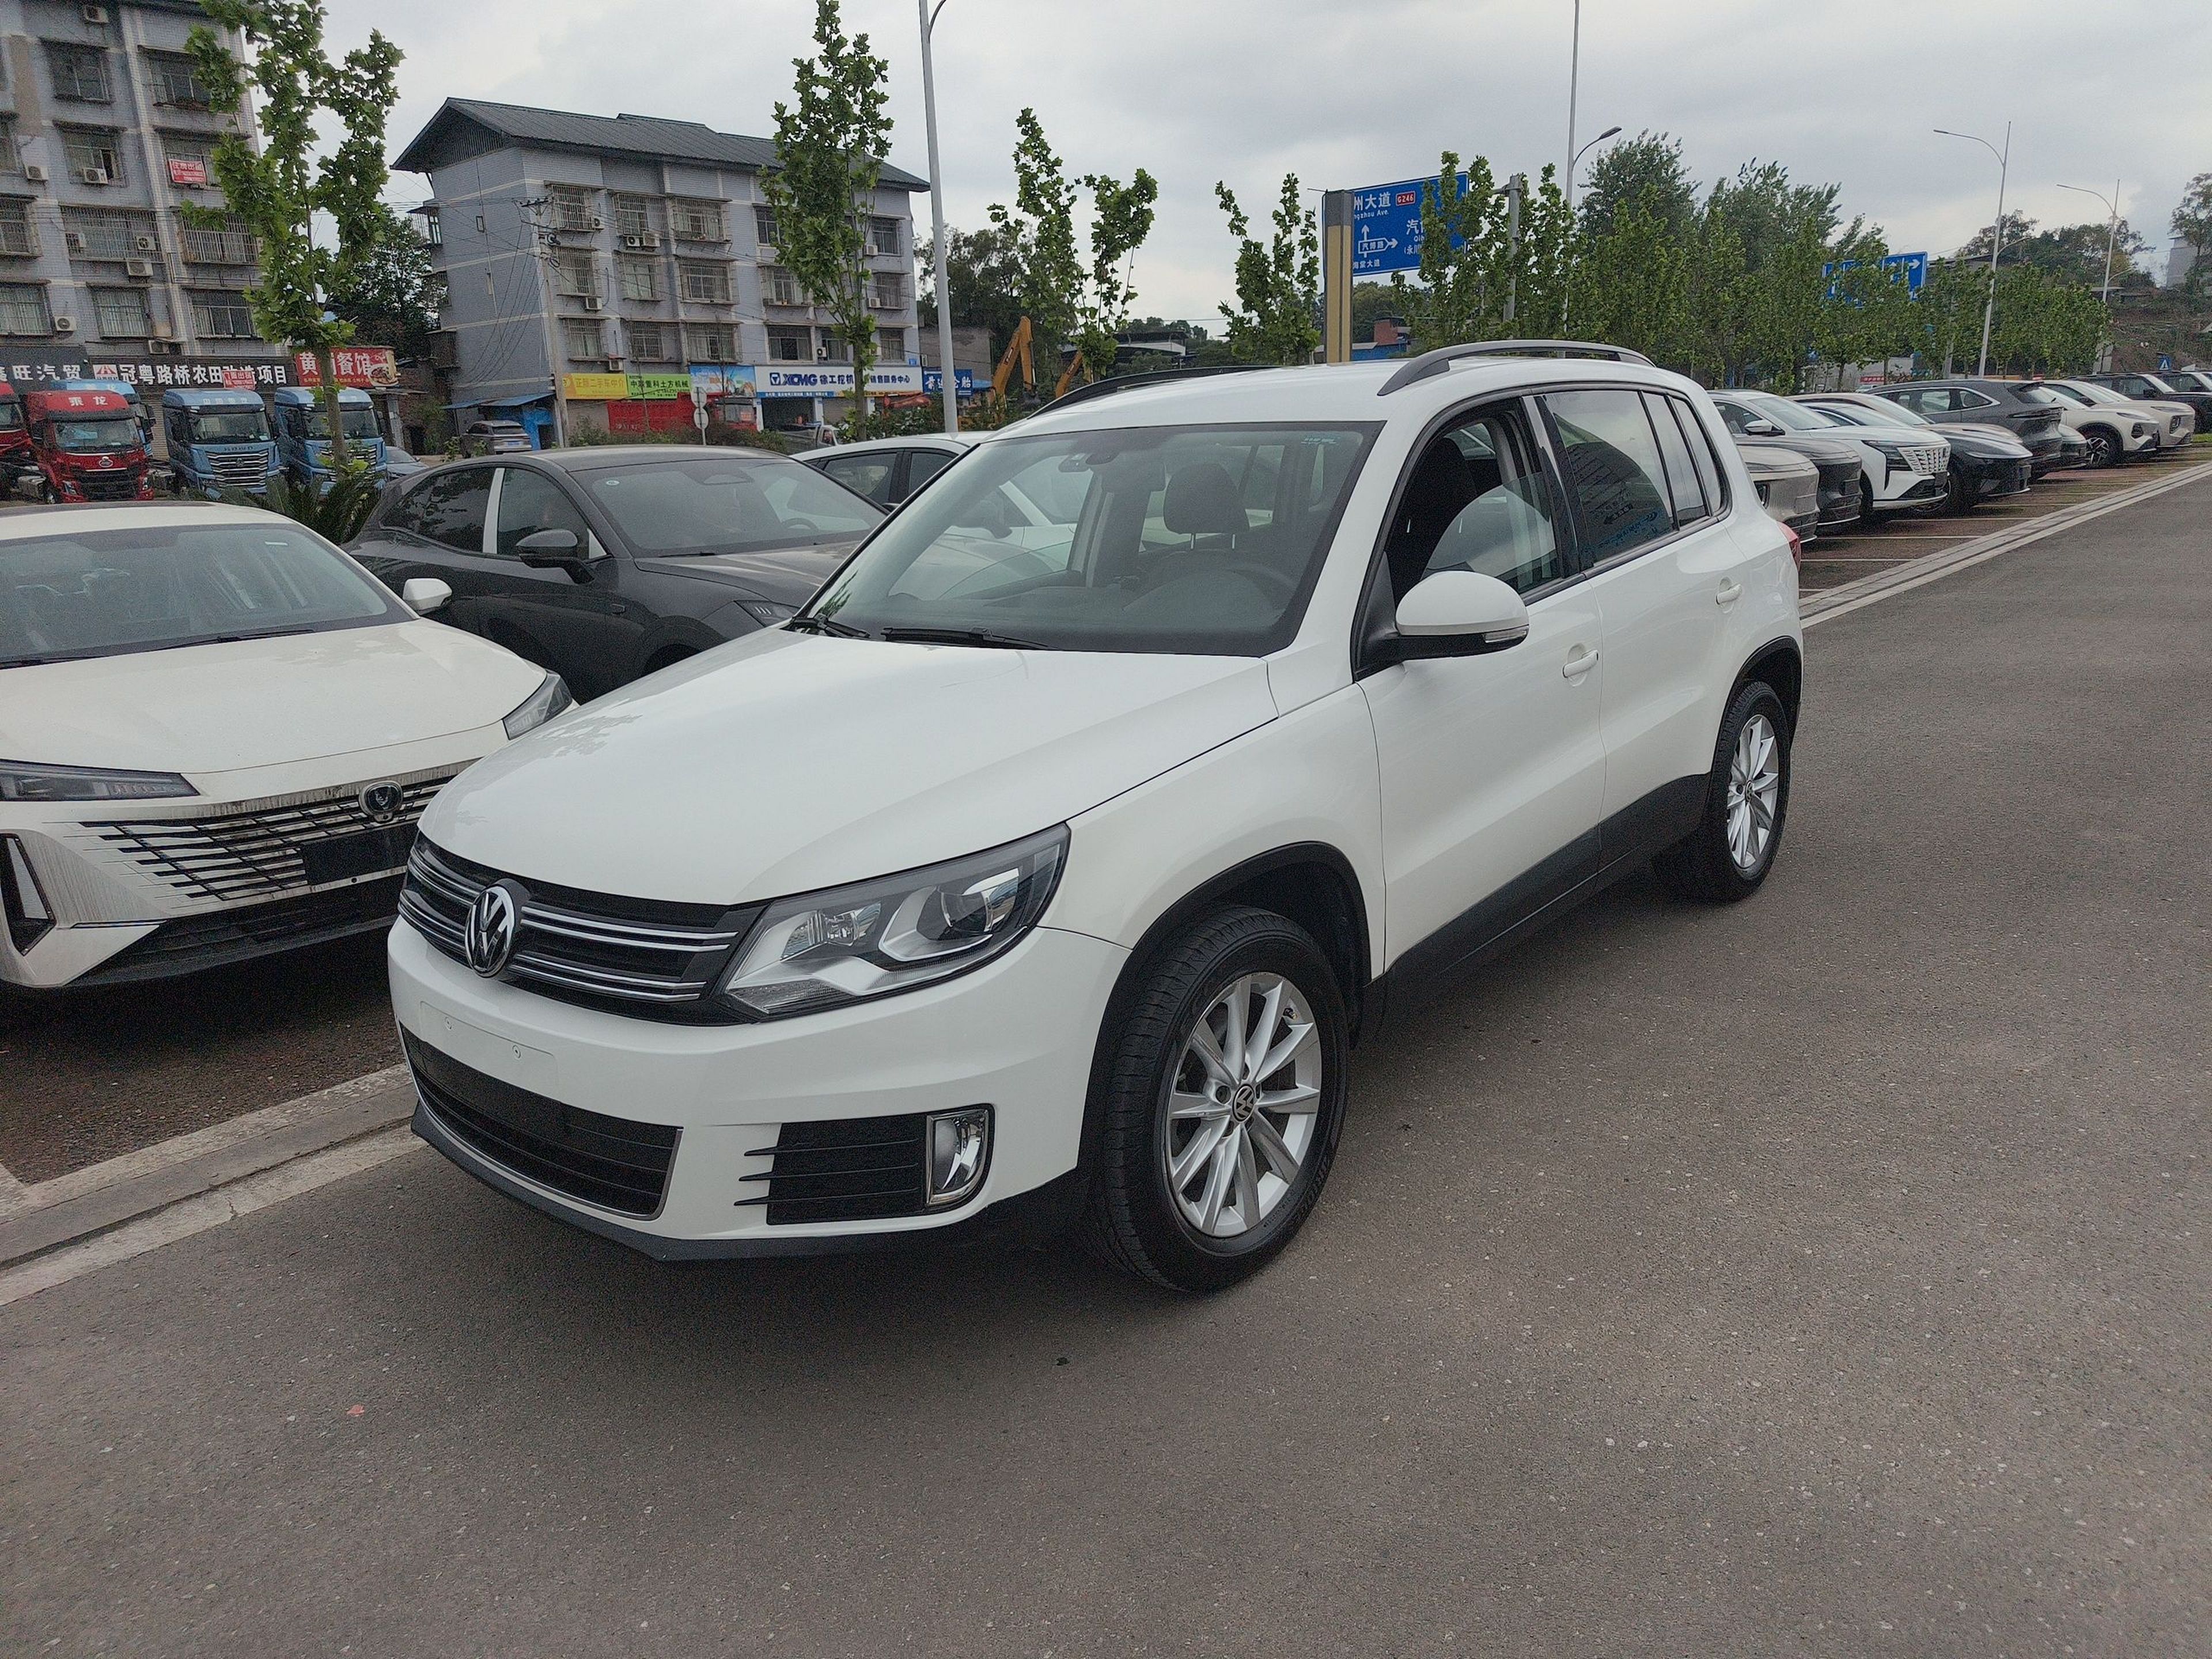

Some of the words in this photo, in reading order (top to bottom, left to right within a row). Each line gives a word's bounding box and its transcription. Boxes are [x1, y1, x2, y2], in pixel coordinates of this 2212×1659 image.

[1397, 194, 1414, 203] G246
[300, 352, 370, 375] 黄餐馆
[119, 364, 287, 385] 冠粤路桥农田项目
[782, 374, 818, 387] XCMG
